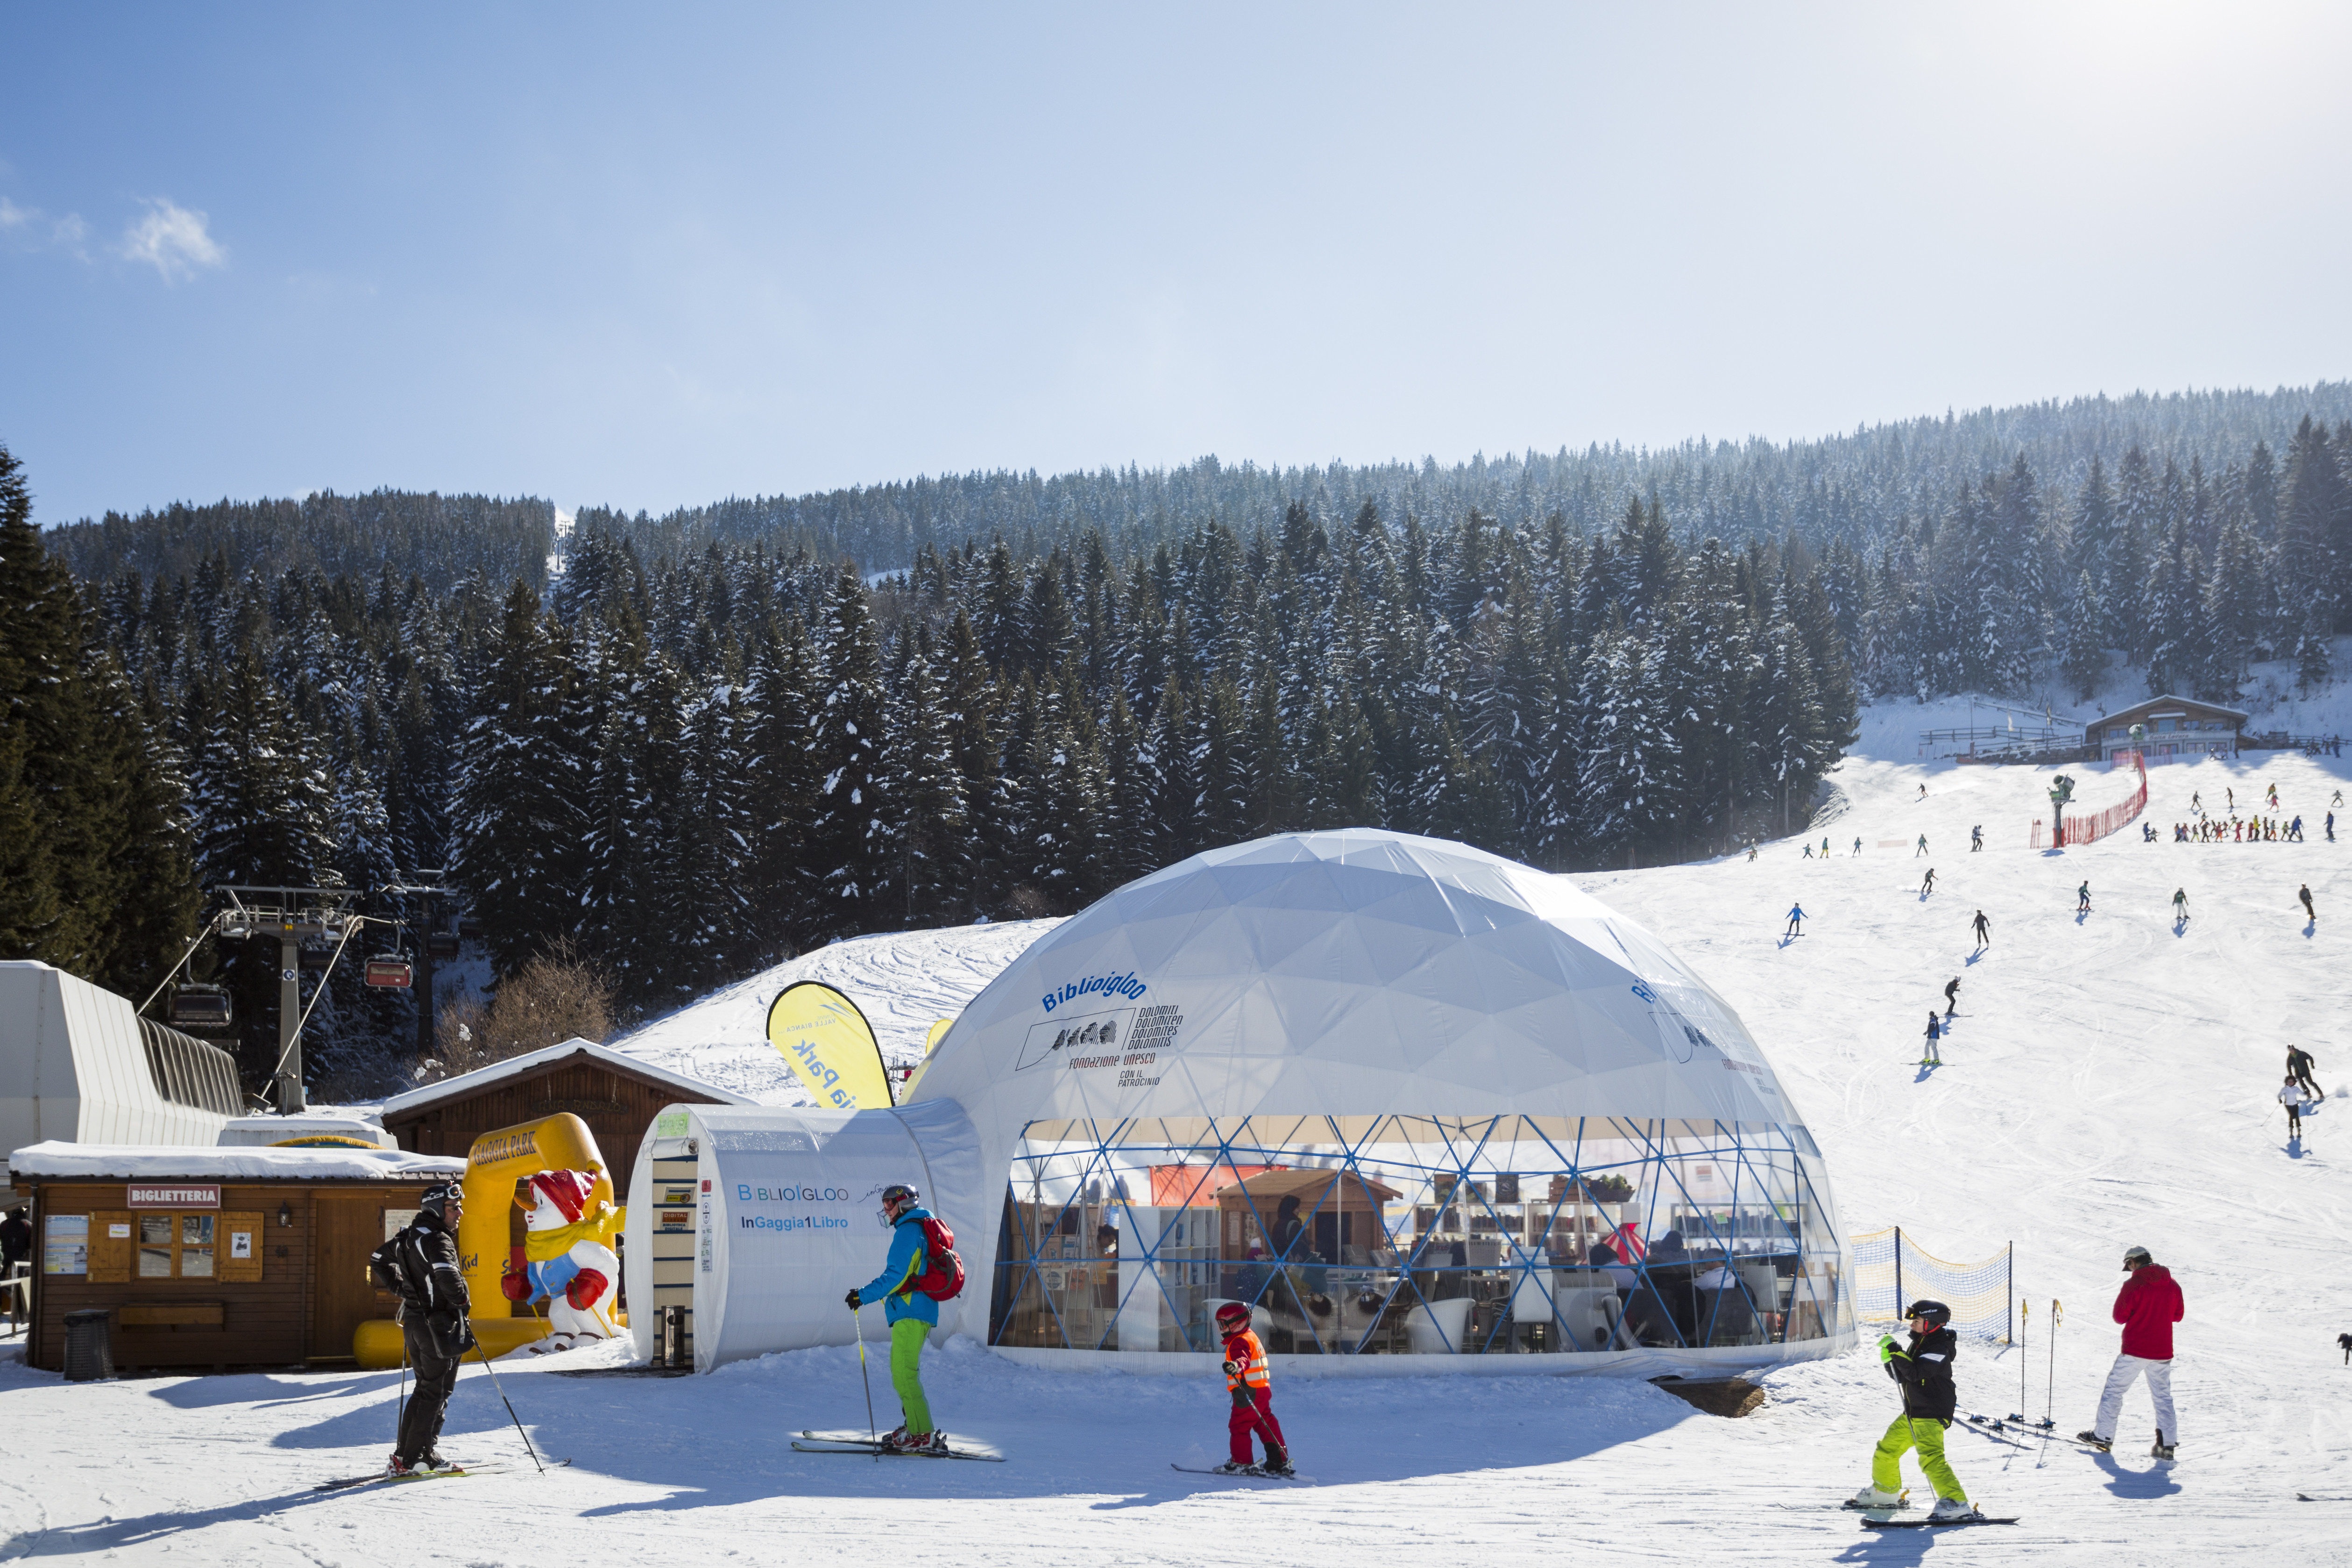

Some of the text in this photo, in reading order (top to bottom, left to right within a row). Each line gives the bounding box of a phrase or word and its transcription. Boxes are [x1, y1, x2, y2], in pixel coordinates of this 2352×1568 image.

[1042, 971, 1147, 1013] Biblioigloo
[1120, 1070, 1134, 1078] CON
[1118, 1077, 1160, 1087] PATROCINIO
[474, 1130, 537, 1166] GAGGIA PARK
[132, 1190, 216, 1201] BIGLIETTERIA
[742, 1216, 849, 1232] InGaggia1Libro
